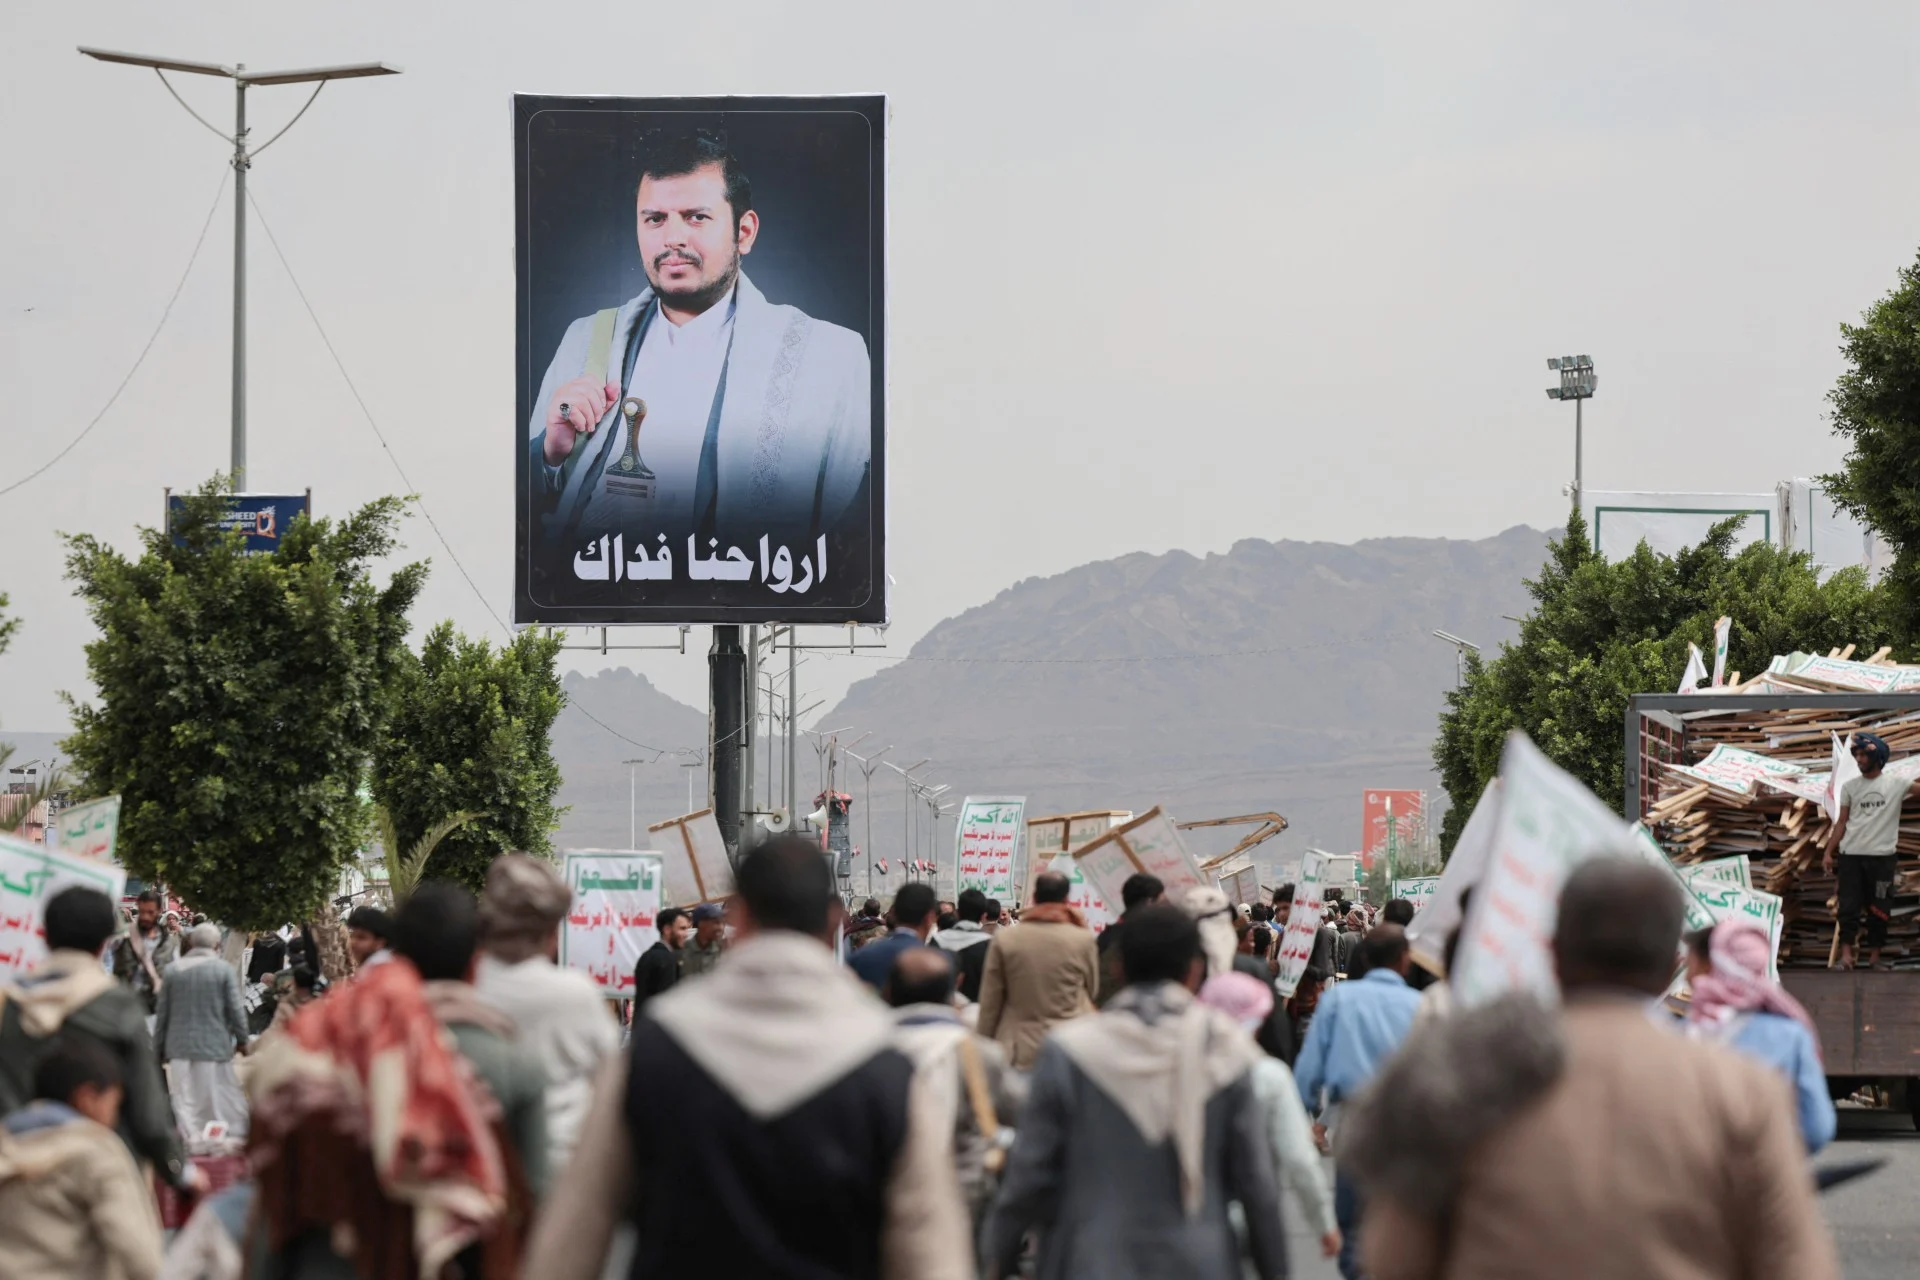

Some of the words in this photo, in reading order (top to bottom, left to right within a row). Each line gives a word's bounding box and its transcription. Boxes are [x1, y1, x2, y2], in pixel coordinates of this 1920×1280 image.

[573, 532, 673, 582] فداك
[687, 532, 828, 593] ارواحنا
[966, 807, 1002, 827] أكبر
[1001, 808, 1019, 823] الله
[1398, 881, 1424, 900] أكبر
[1743, 895, 1773, 918] الله
